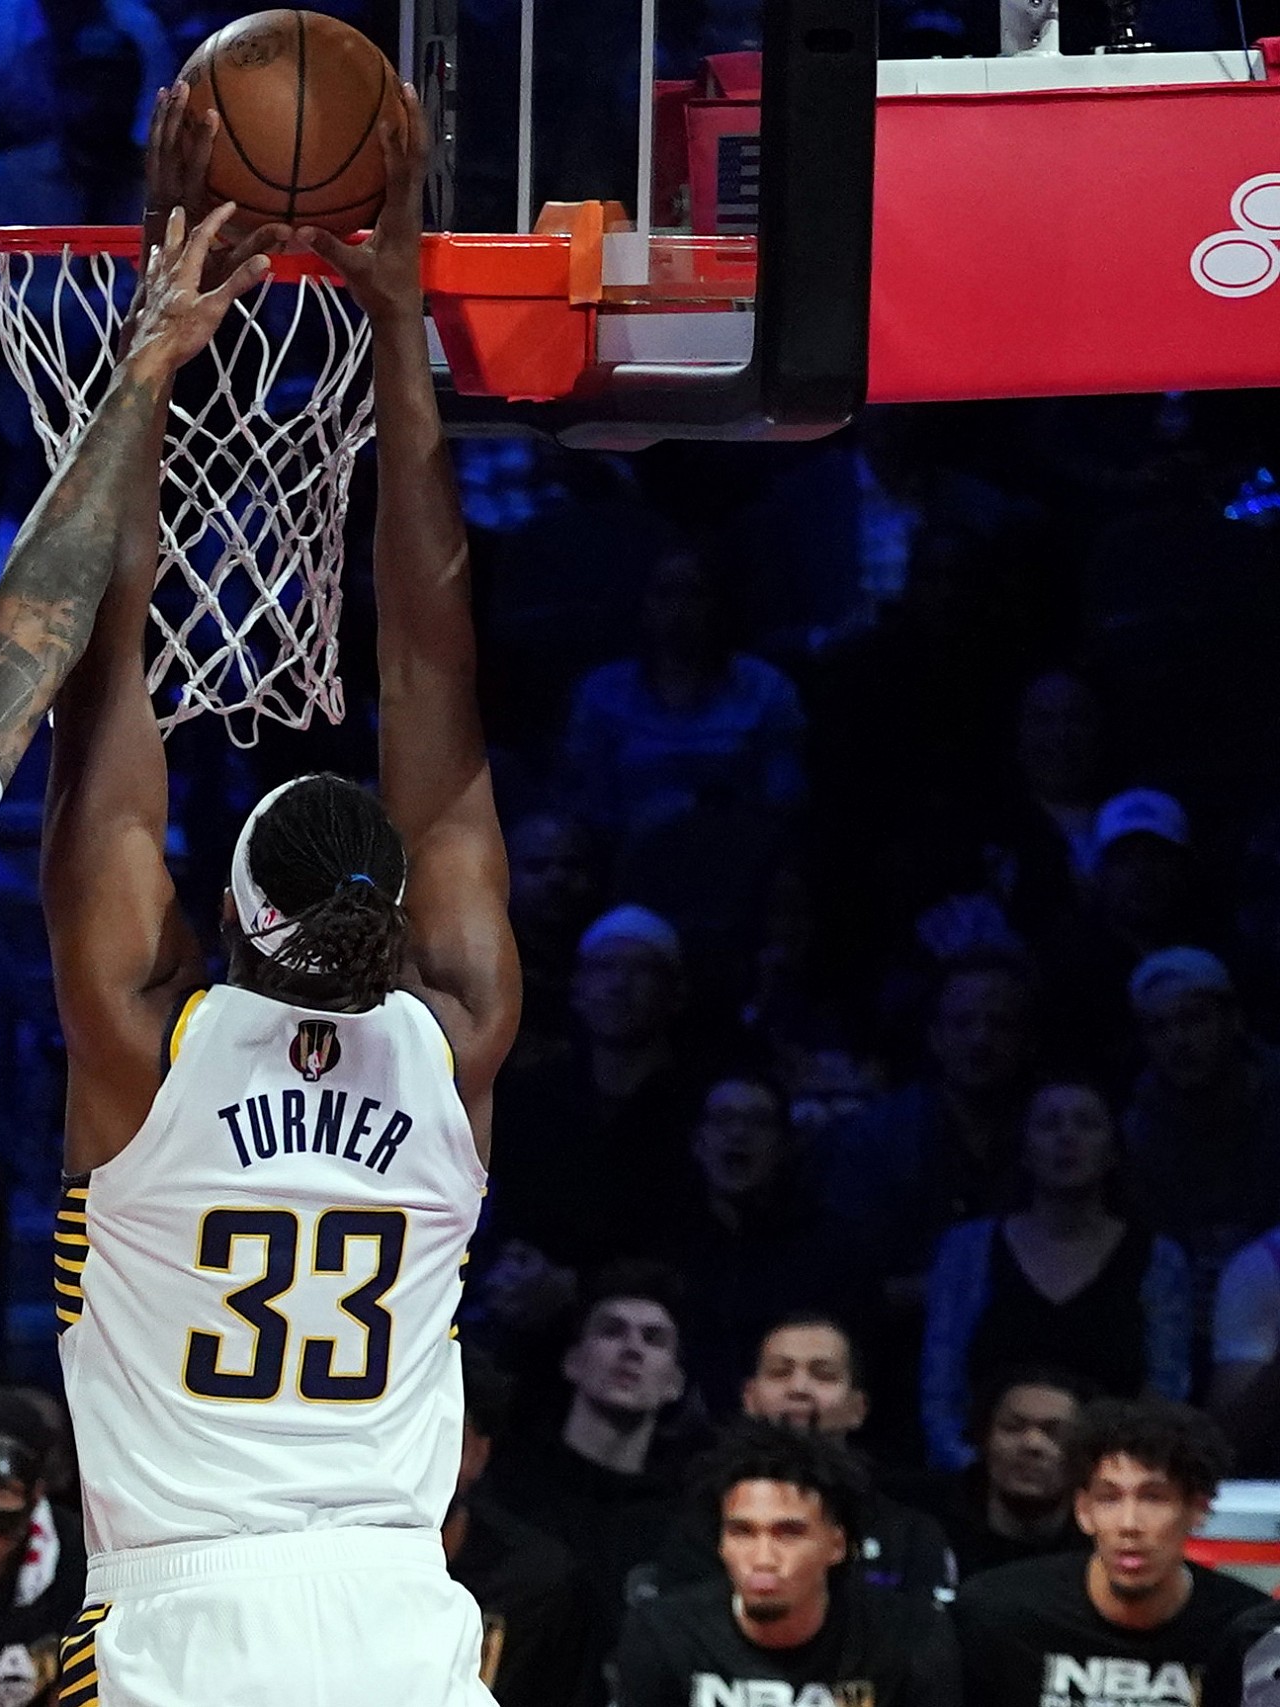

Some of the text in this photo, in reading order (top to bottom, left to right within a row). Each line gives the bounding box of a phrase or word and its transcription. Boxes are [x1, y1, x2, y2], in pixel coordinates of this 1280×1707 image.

[218, 1089, 413, 1174] TURNER
[183, 1207, 407, 1403] 33
[1041, 1652, 1195, 1700] NBA
